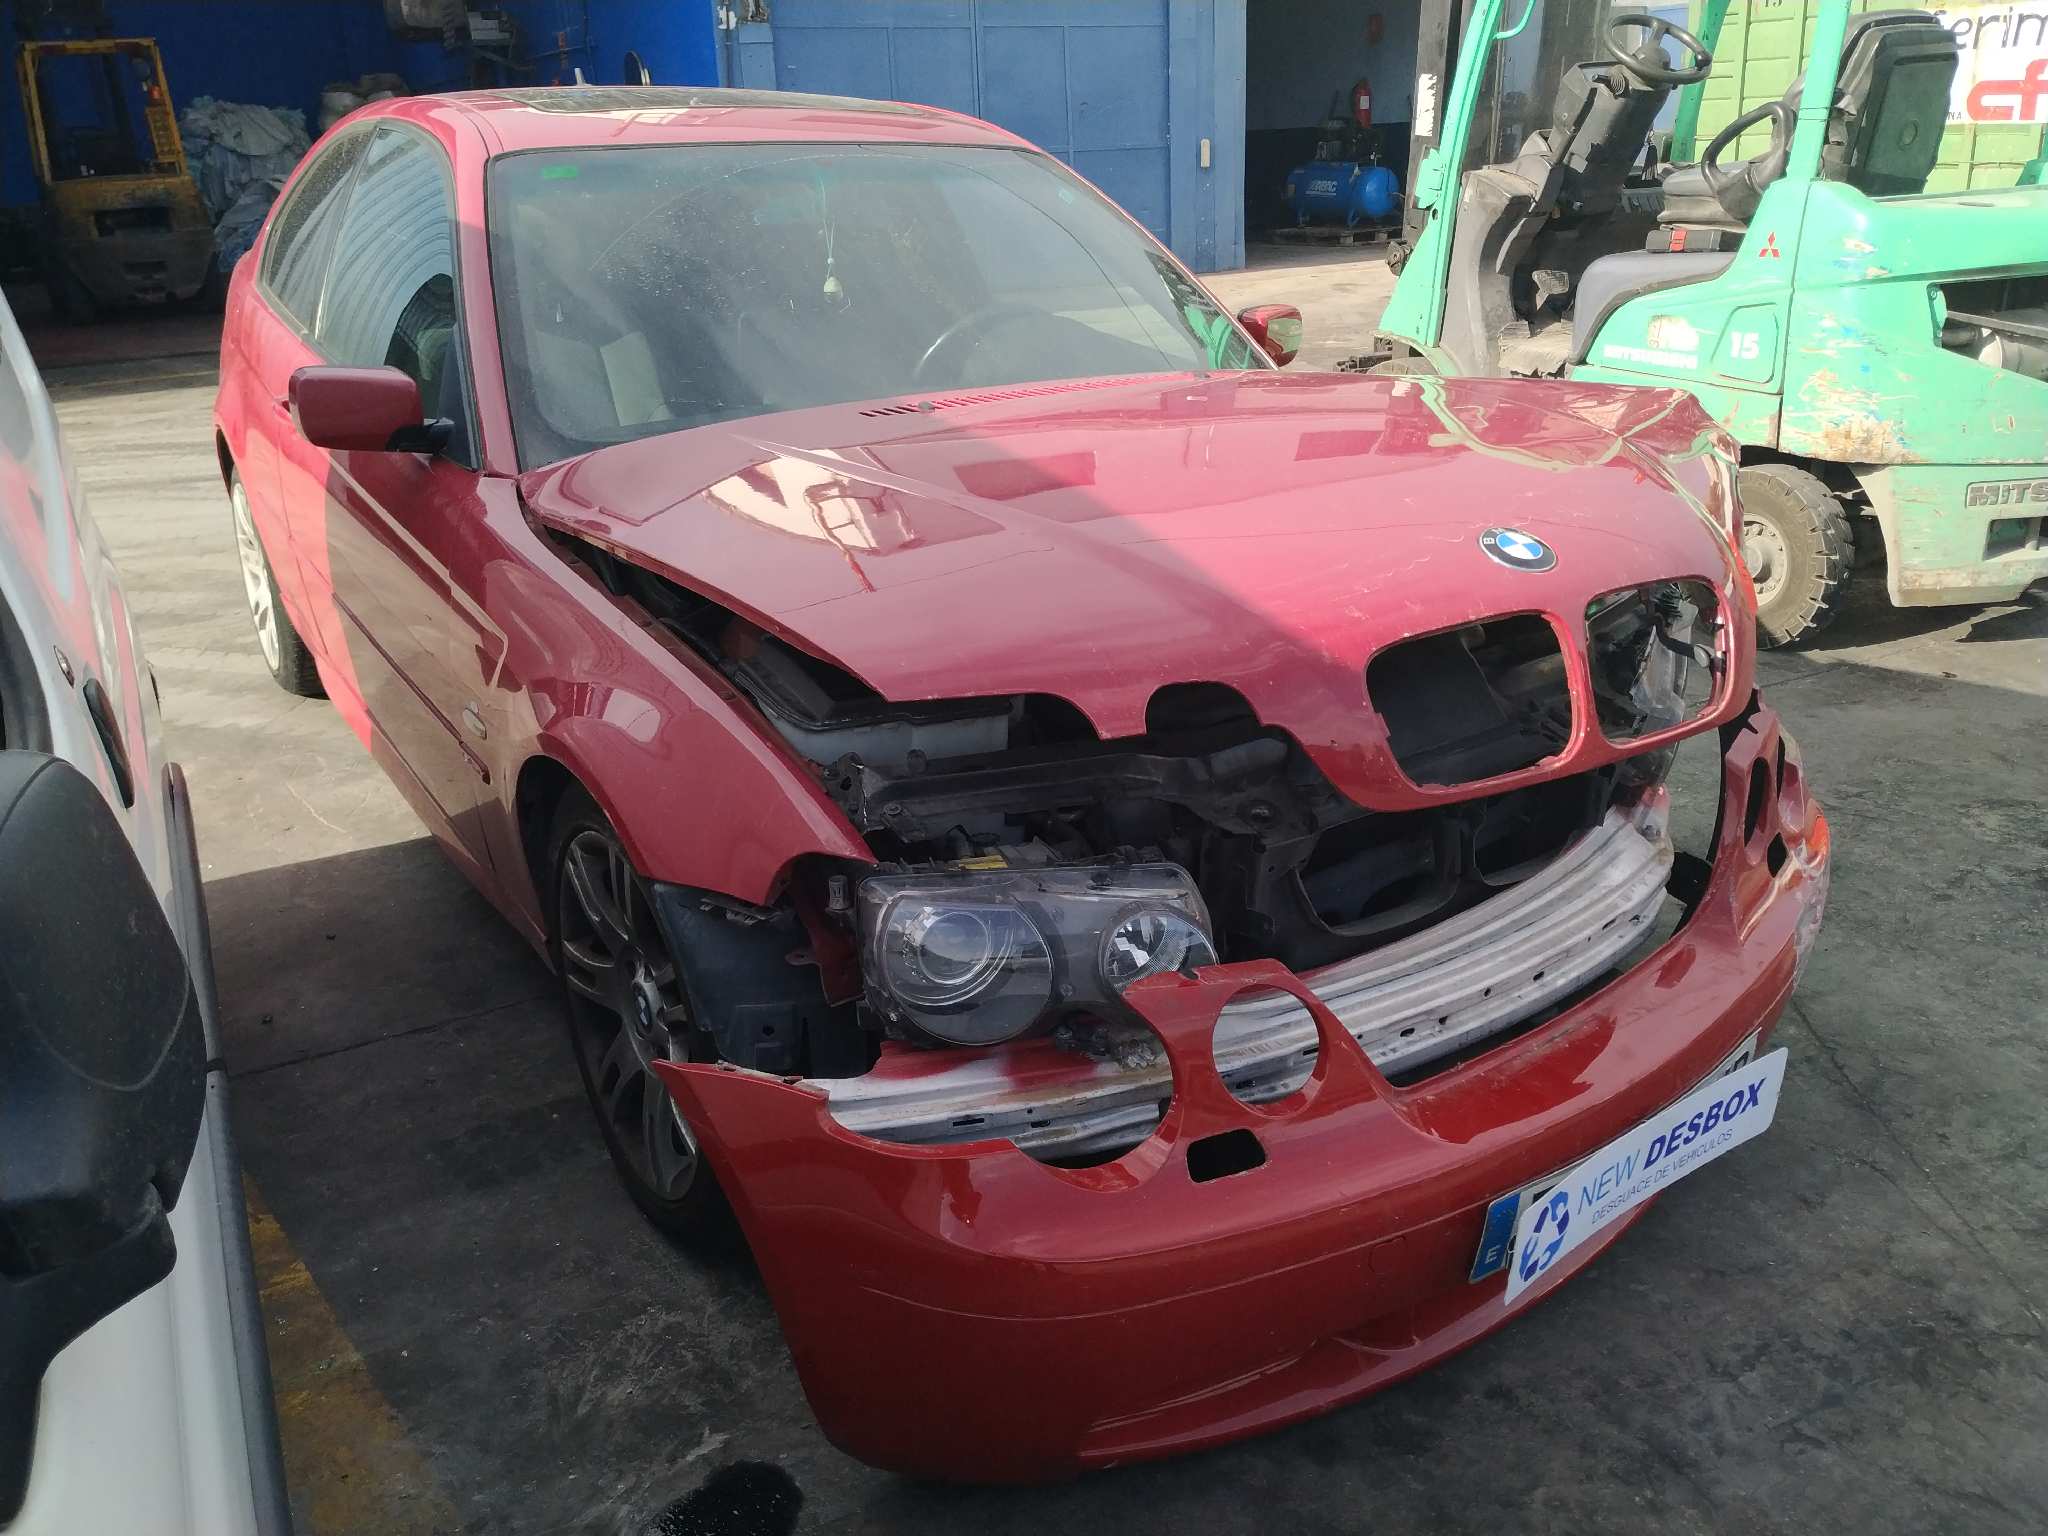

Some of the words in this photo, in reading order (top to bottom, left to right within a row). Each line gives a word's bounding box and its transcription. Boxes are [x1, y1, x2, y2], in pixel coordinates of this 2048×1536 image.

[1730, 331, 1760, 359] 15
[1577, 1149, 1641, 1215] NEW
[1643, 1077, 1767, 1170] DESBOX
[1592, 1175, 1653, 1224] DESGUACE
[1654, 1164, 1671, 1184] DE
[1485, 1245, 1501, 1264] E
